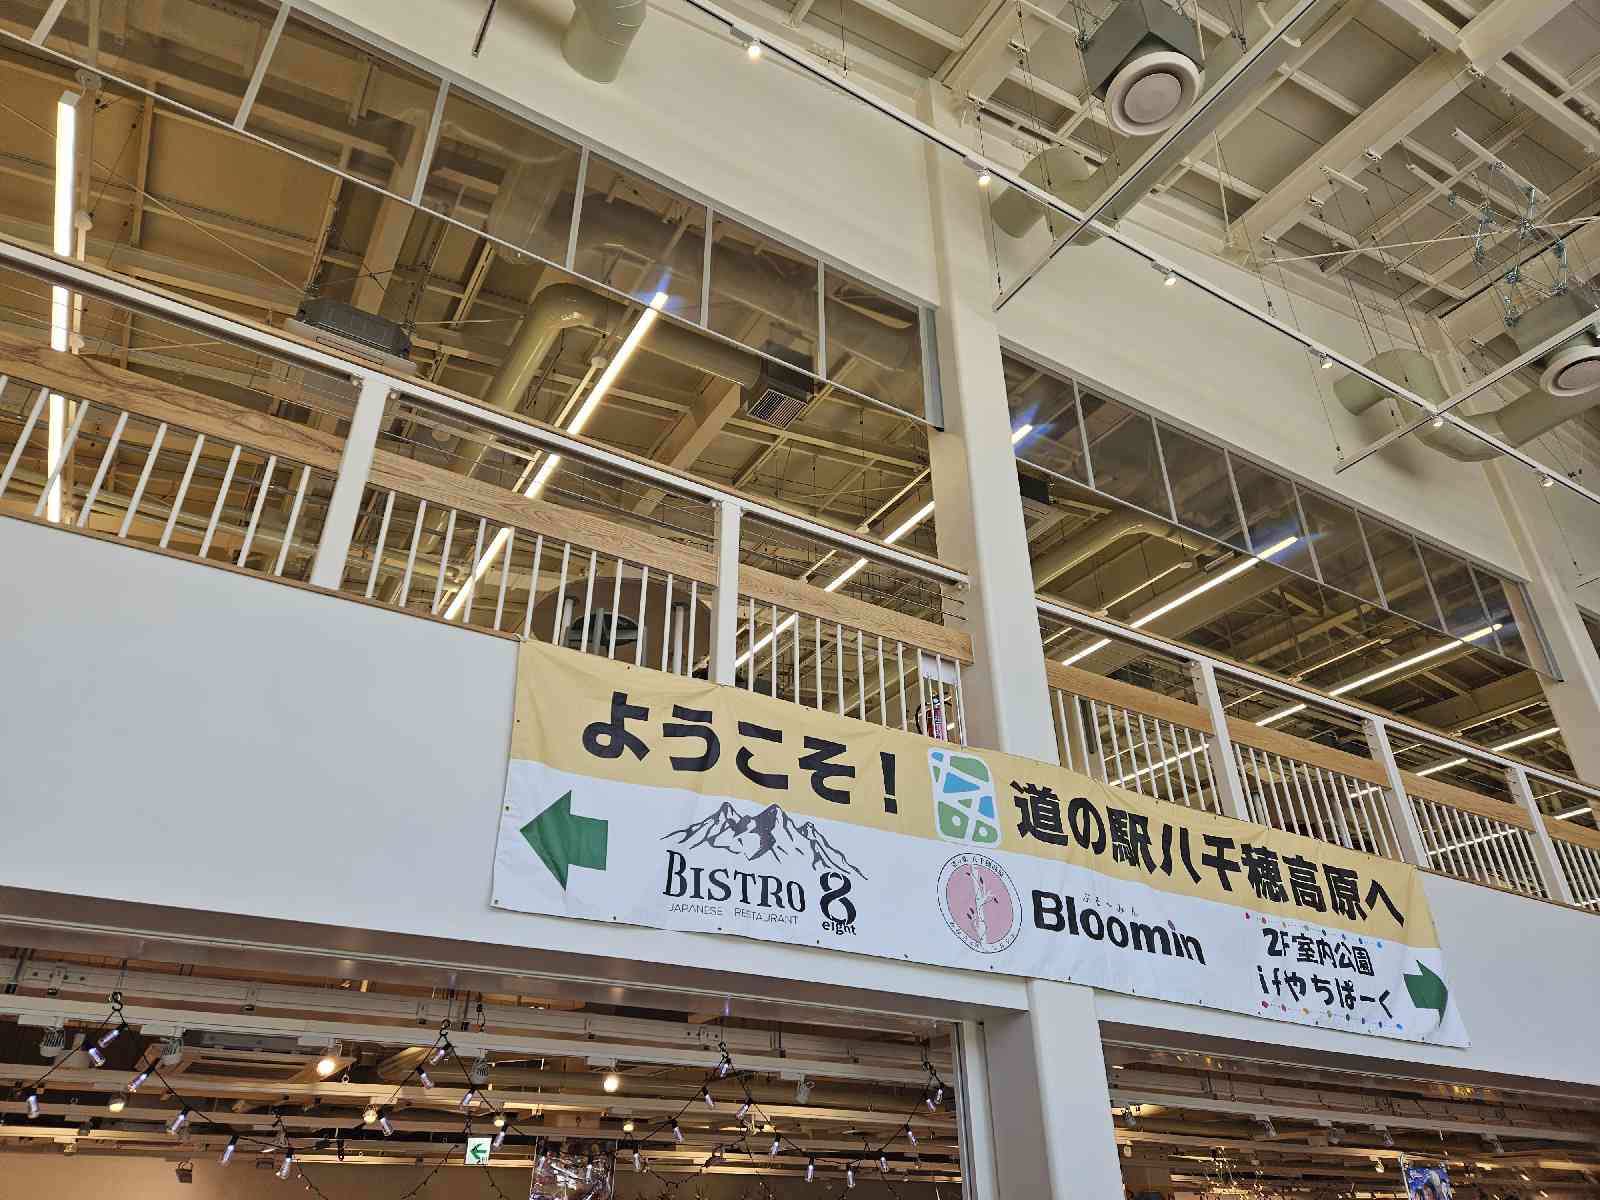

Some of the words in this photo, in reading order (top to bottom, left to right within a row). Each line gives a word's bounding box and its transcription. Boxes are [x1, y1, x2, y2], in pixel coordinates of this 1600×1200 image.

[582, 691, 898, 813] ようこそ！
[1010, 780, 1405, 928] 道の駅八千穂高原へ
[662, 850, 806, 912] BISTRO
[819, 871, 856, 924] 8
[668, 903, 723, 916] JAPANESE
[821, 919, 857, 936] eight
[1031, 889, 1207, 966] Bloomin
[1262, 927, 1375, 977] 2F室内公園
